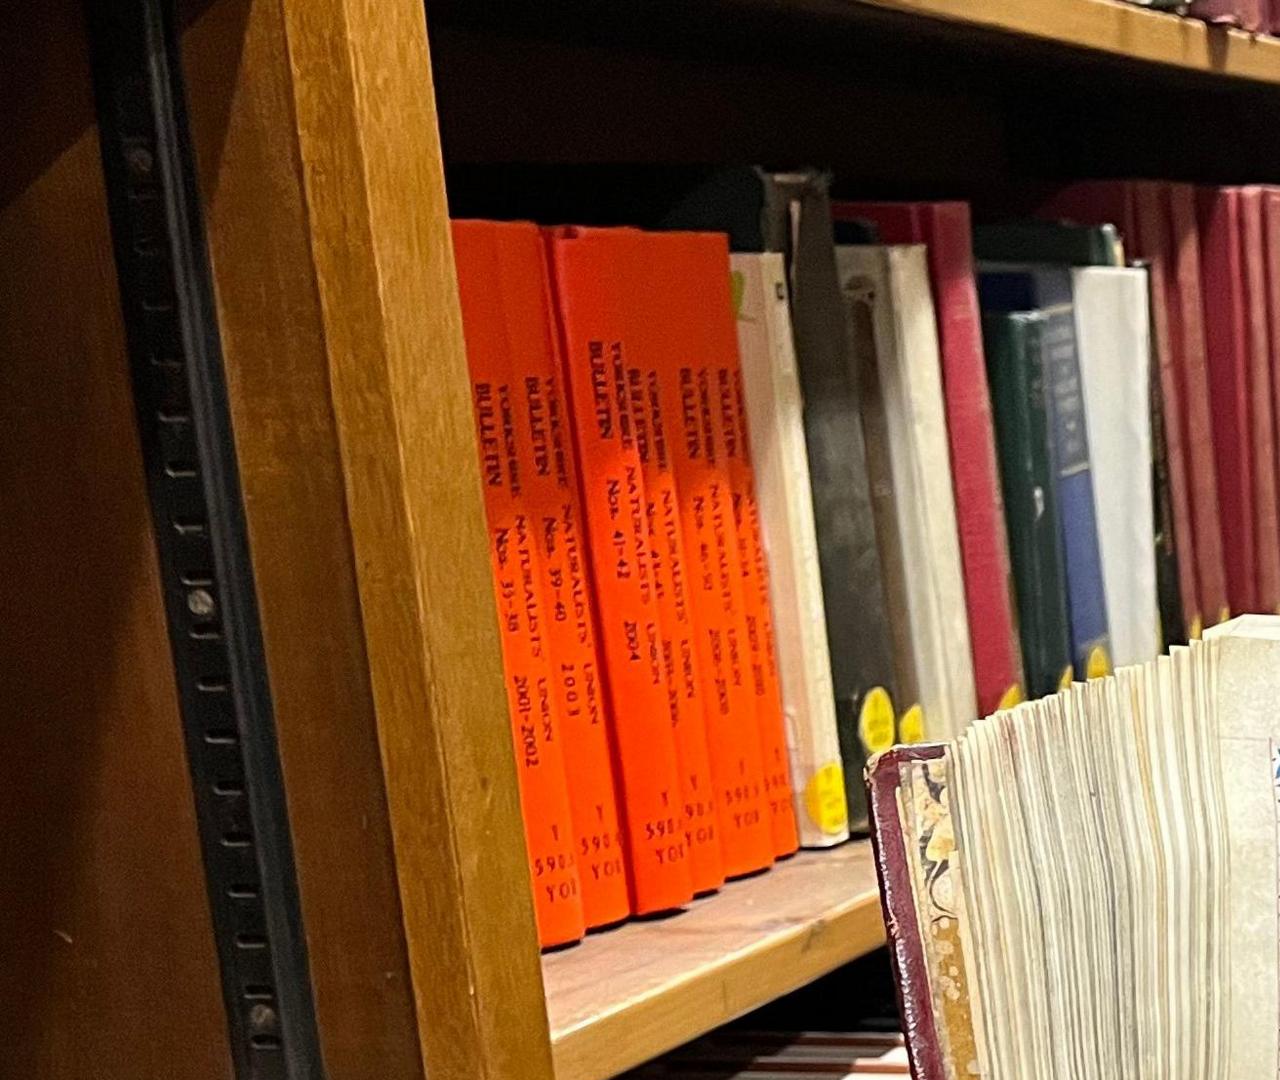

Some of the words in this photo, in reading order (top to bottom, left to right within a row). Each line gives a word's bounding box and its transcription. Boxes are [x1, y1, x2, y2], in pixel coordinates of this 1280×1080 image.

[476, 384, 502, 486] BULLETIN
[525, 376, 550, 476] BULLETIN
[588, 341, 613, 439] BULLETIN
